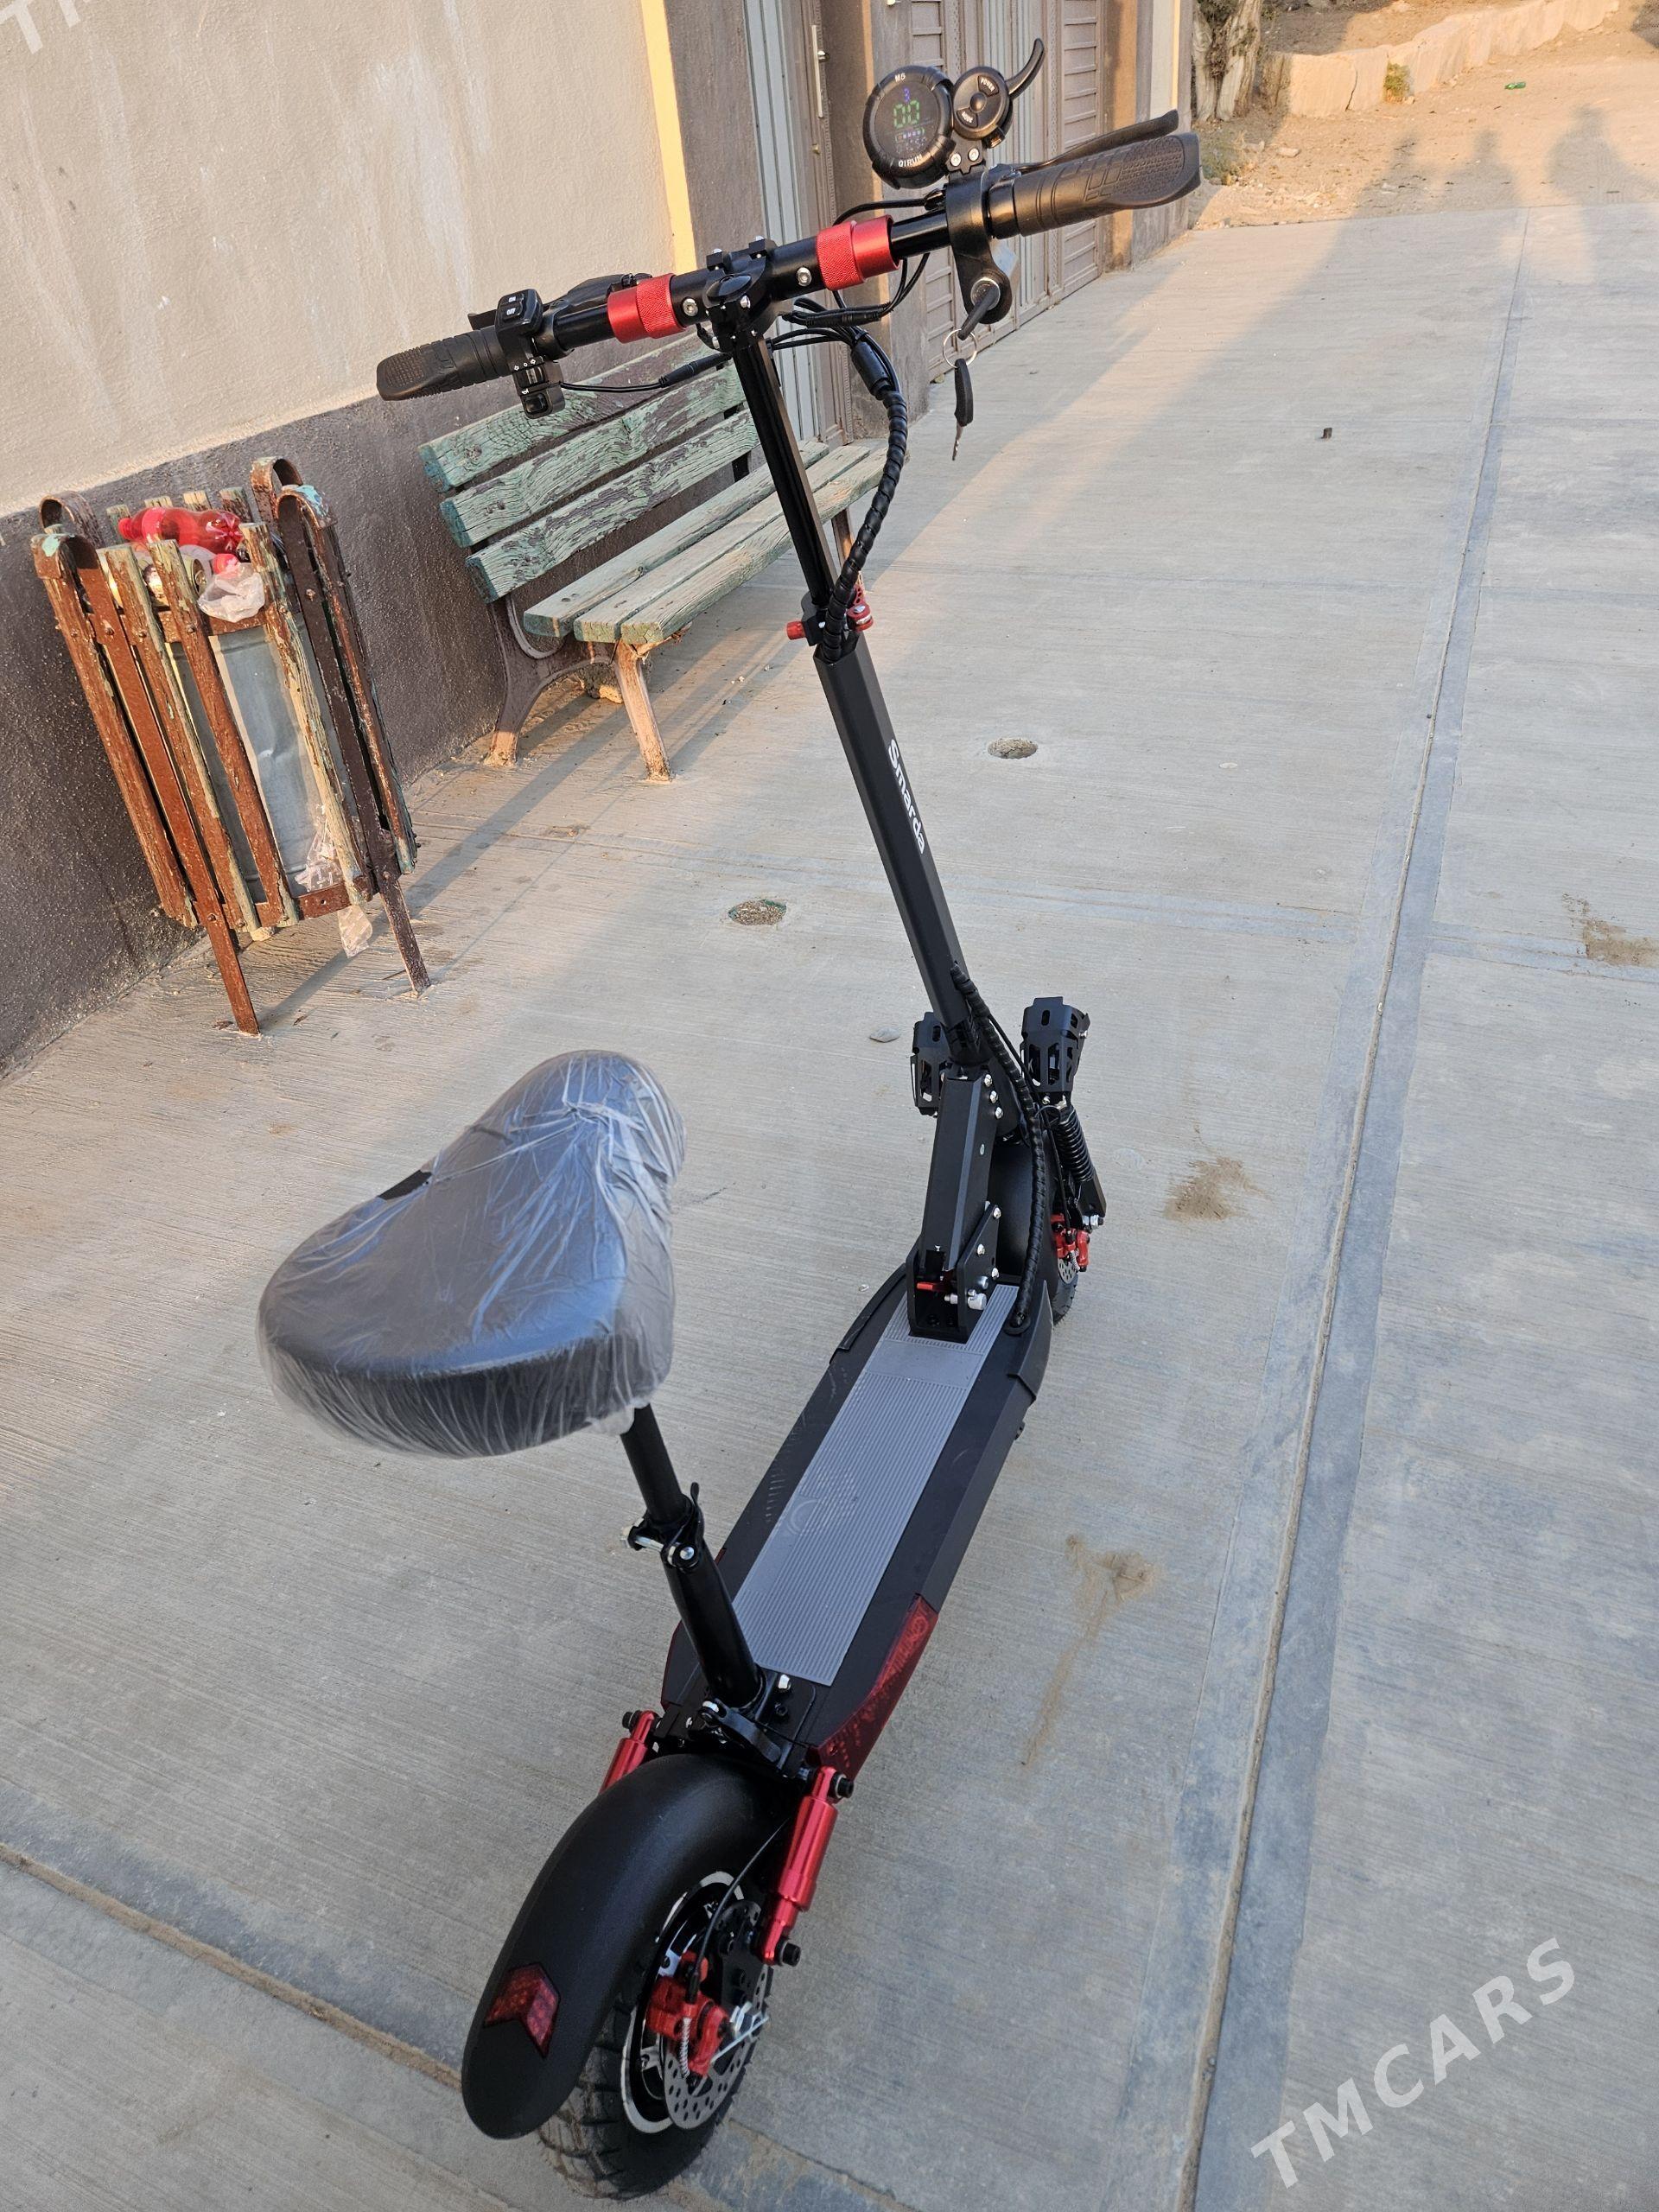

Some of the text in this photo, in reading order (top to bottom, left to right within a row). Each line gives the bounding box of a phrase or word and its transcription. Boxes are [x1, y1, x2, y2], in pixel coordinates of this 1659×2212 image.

[980, 77, 995, 92] POWER
[899, 154, 923, 168] QIRUN
[888, 739, 925, 855] Smarda
